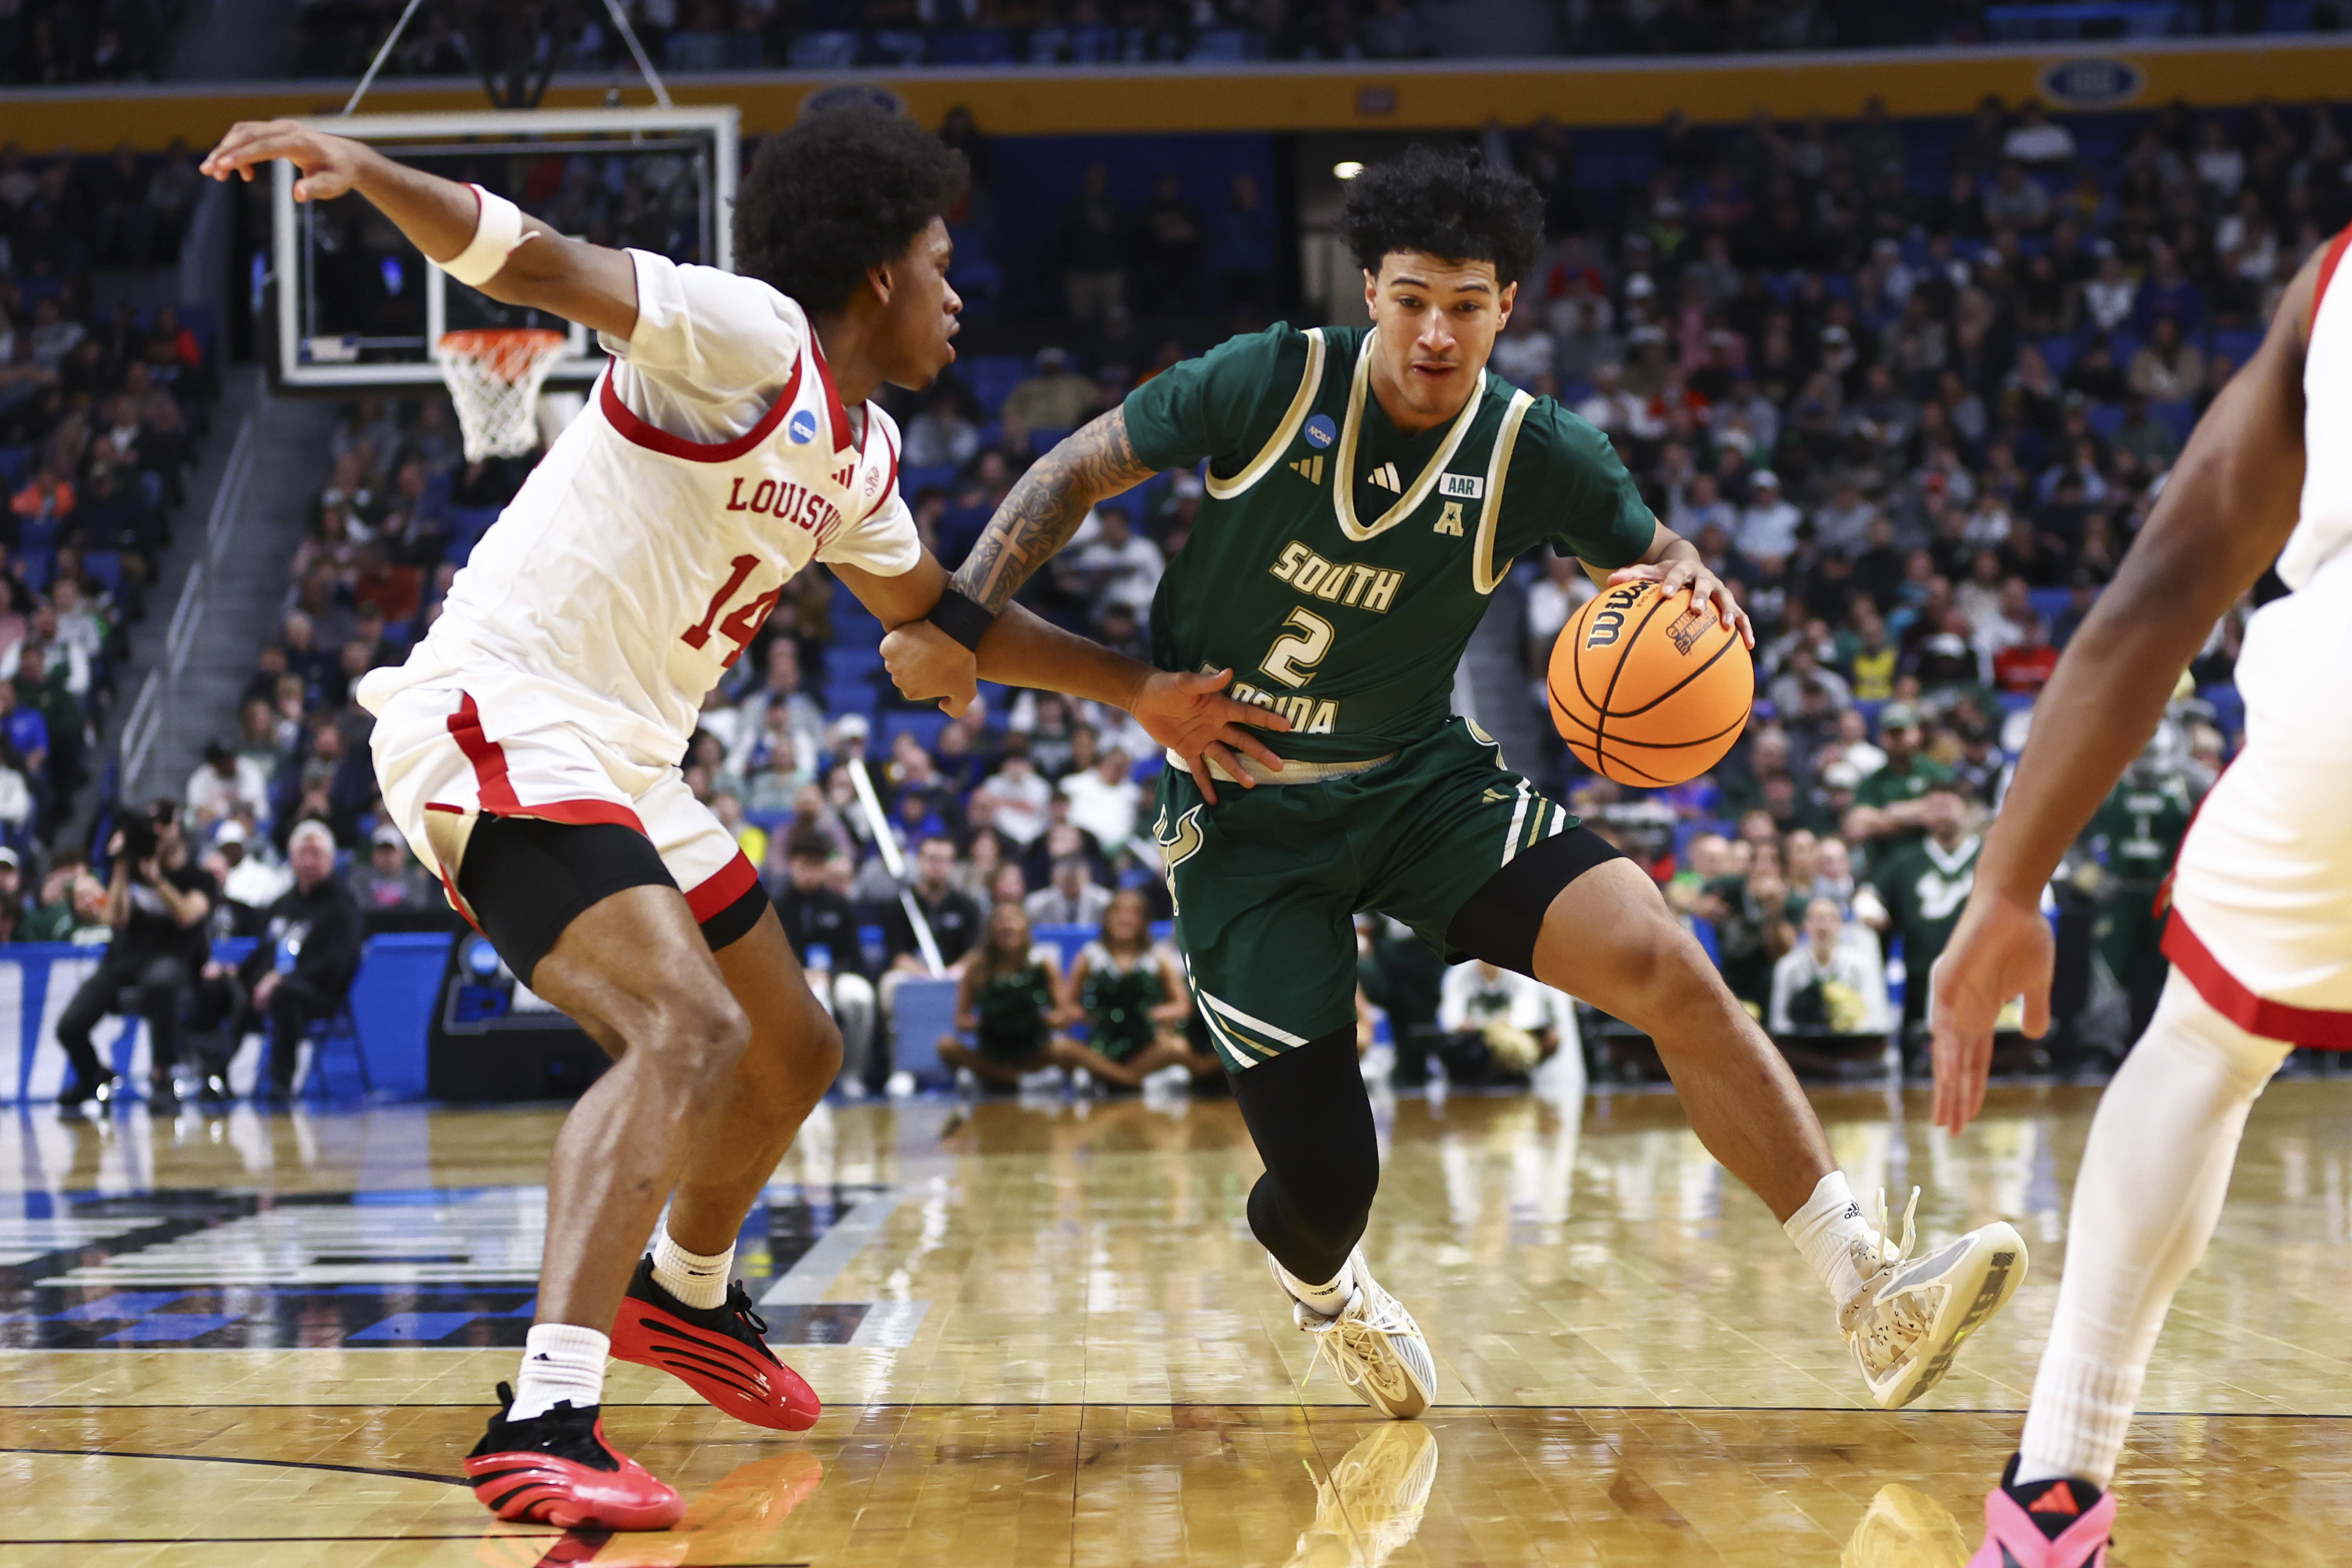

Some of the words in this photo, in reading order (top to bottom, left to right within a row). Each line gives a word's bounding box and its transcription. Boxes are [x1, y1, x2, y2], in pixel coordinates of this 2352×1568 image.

[1308, 425, 1331, 445] NCAA
[726, 477, 843, 558] LOUISV
[1433, 500, 1465, 537] A
[1448, 477, 1475, 495] AAR
[681, 554, 781, 669] 14
[1269, 539, 1406, 613] SOUTH
[1258, 605, 1335, 690] 2
